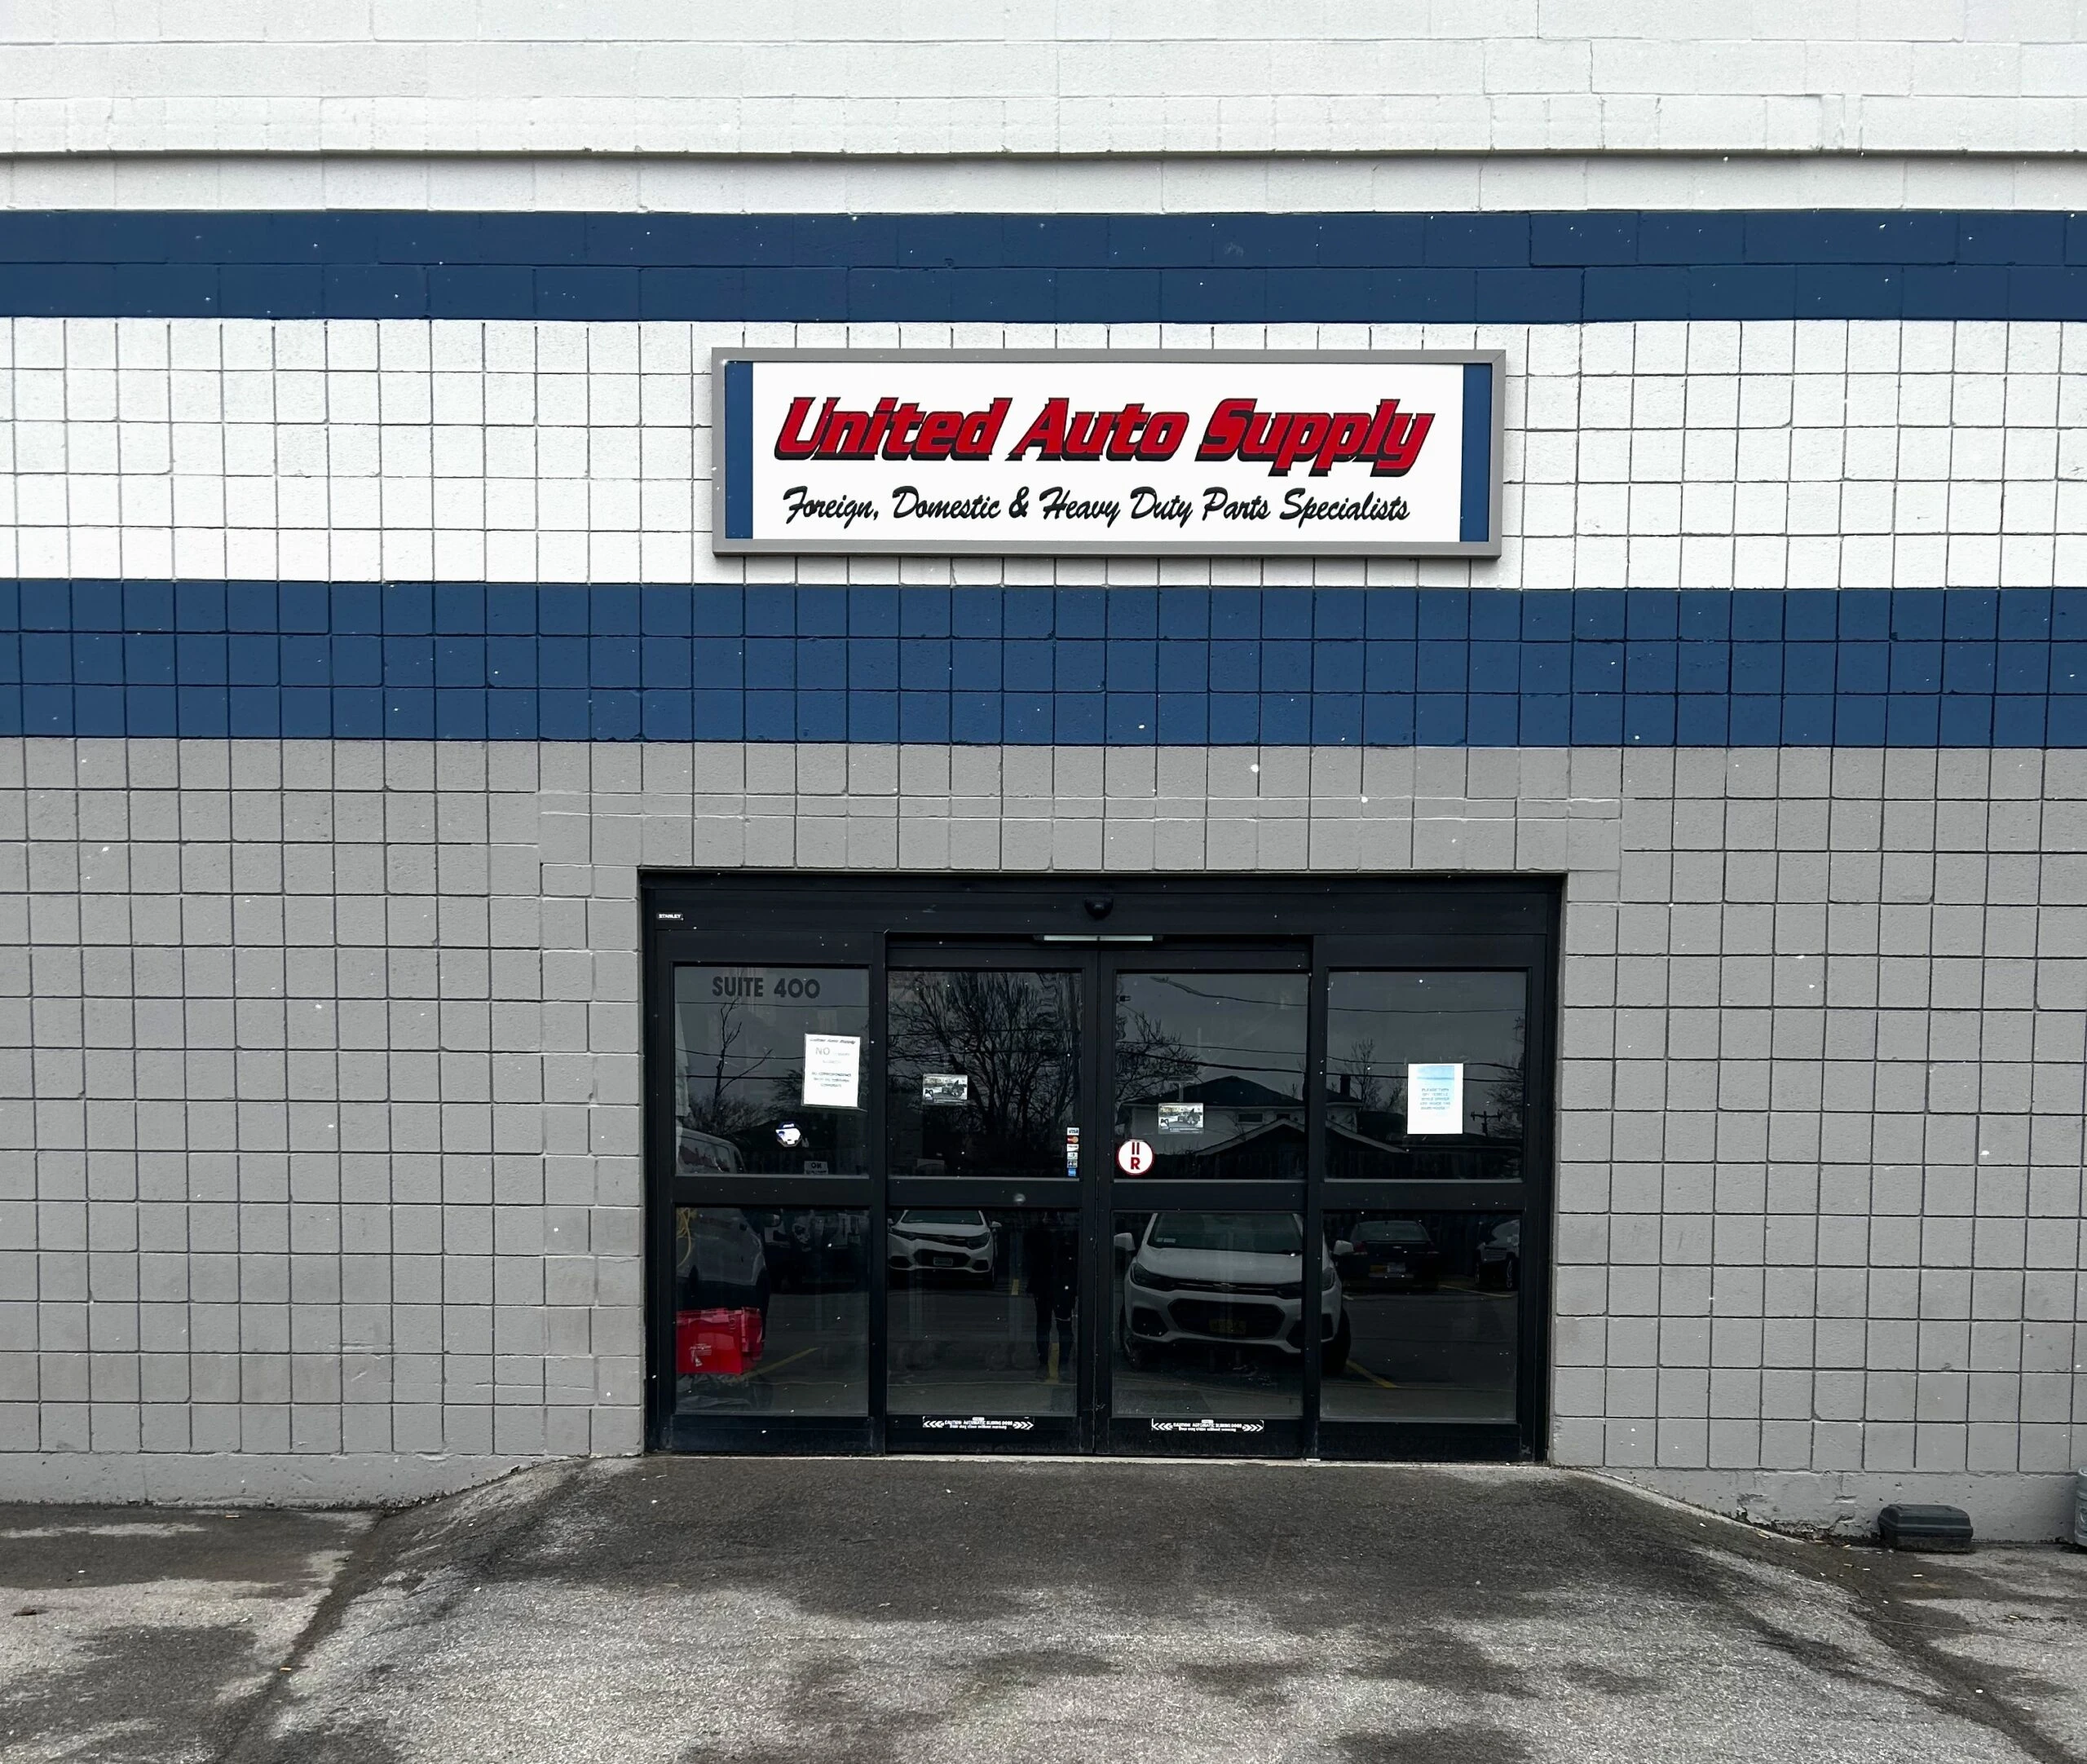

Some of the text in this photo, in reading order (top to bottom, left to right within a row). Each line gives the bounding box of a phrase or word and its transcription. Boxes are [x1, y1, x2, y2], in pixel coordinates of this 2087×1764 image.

[774, 396, 1436, 478] United Auto Supply
[783, 485, 1410, 529] Foreign, Domestic & Heavy Duty Parts Specialists
[712, 976, 821, 999] SUITE 400
[815, 1047, 831, 1056] NO
[1130, 1157, 1141, 1170] R
